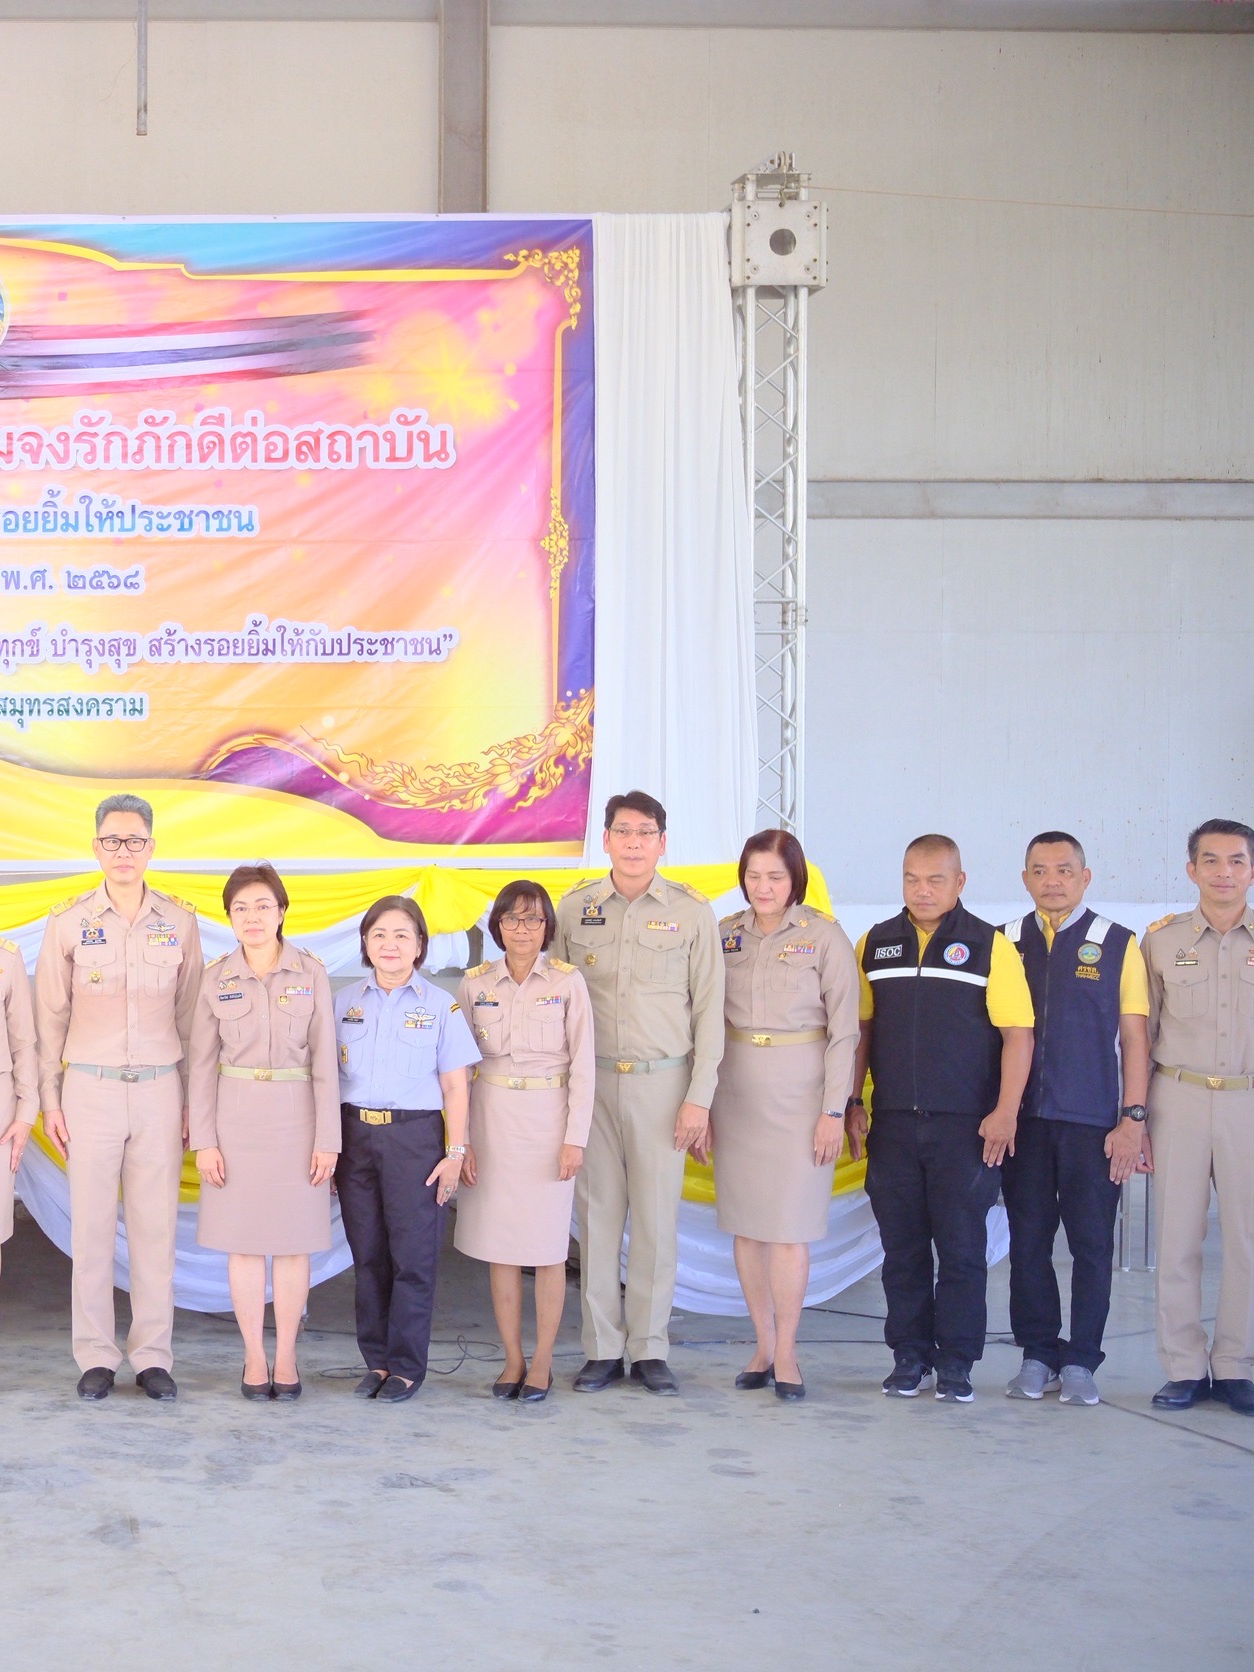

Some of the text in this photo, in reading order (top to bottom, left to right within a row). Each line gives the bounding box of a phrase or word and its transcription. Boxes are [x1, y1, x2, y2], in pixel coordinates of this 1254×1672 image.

[0, 566, 54, 591] พ.ศ.
[65, 566, 141, 592] ๒๕๖๘
[50, 630, 139, 669] บำรุงสุข
[876, 947, 901, 958] ISOC
